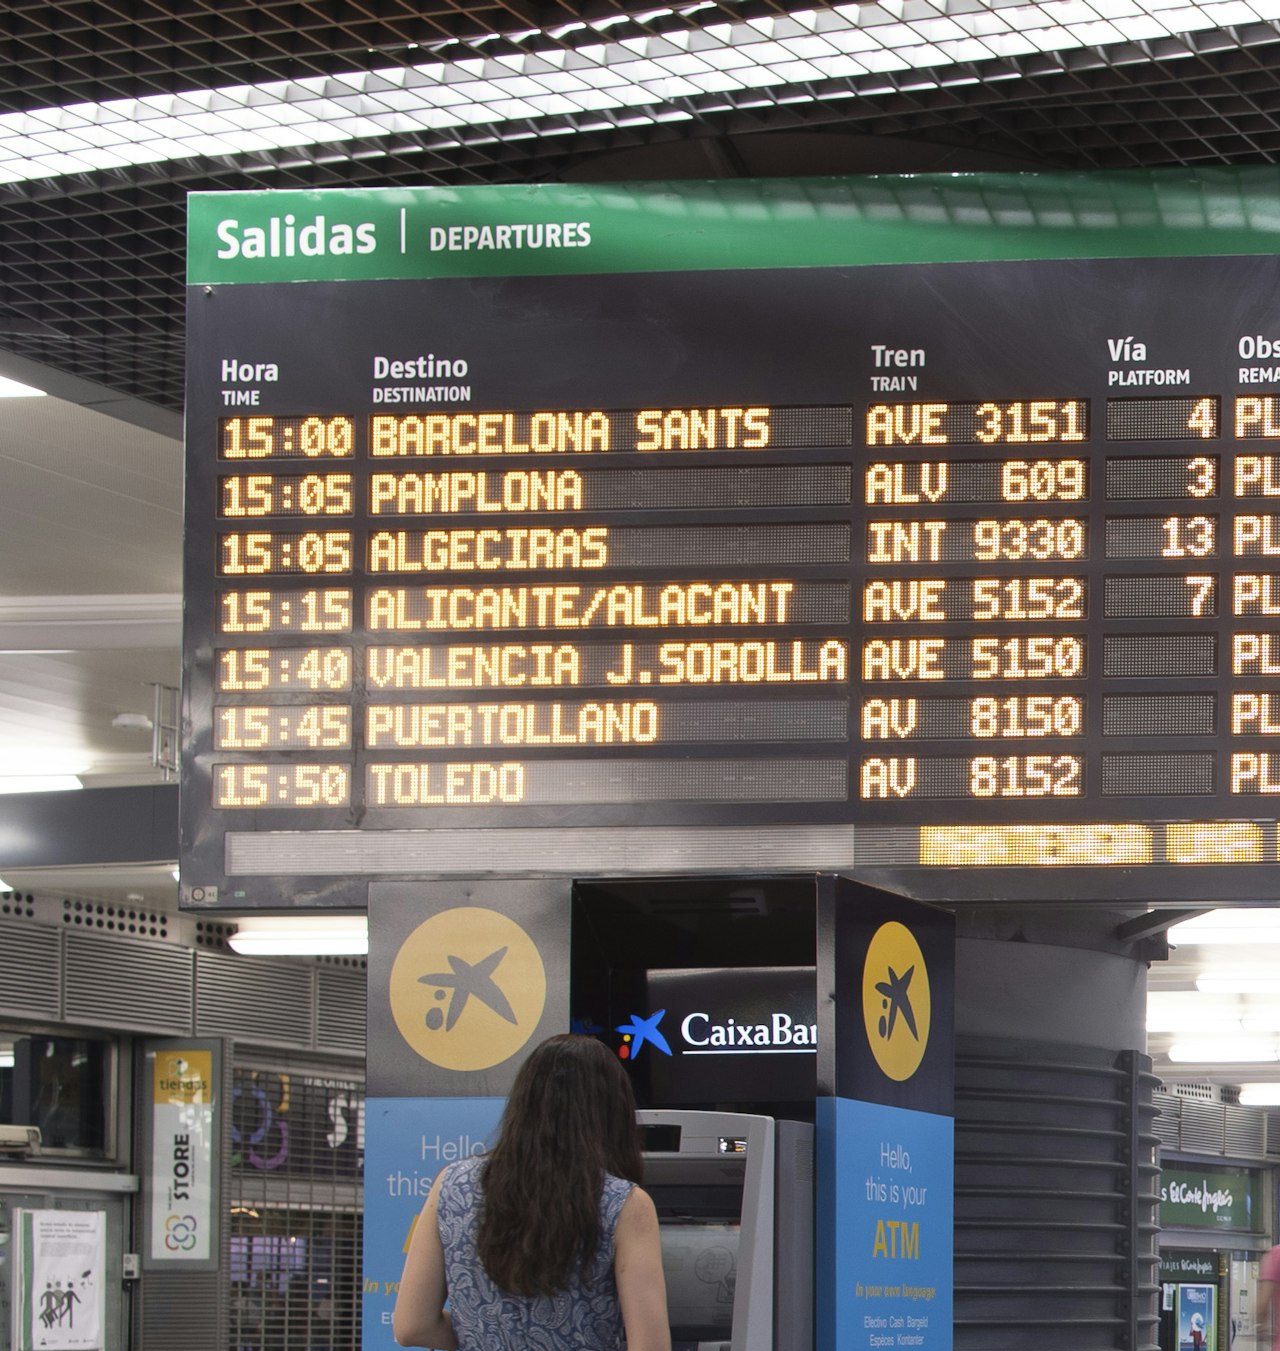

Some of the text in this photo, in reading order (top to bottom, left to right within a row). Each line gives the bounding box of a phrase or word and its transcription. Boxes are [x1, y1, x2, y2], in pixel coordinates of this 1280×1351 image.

[217, 214, 591, 259] Salidas DEPARTURES
[222, 360, 278, 381] Hora
[375, 354, 467, 378] Destino
[871, 345, 925, 367] Tren
[1108, 337, 1146, 361] Vía
[222, 391, 259, 405] TIME
[373, 386, 470, 402] DESTINATION
[871, 377, 917, 391] TRAIN
[1109, 370, 1189, 385] PLATFORM
[225, 417, 352, 458] 15:00
[372, 411, 610, 456] BARCELONA
[637, 408, 770, 451] SANTS
[867, 404, 948, 445] AVE
[976, 401, 1083, 443] 3151
[1188, 398, 1214, 438] 4
[224, 474, 351, 516] 15:05
[371, 470, 582, 514] PAMPLONA
[865, 462, 947, 504] ALV
[1002, 460, 1083, 501] 609
[1187, 457, 1214, 497] 3
[223, 532, 350, 574] 15:05
[371, 528, 608, 572] ALGECIRAS
[869, 521, 946, 562] INT
[974, 519, 1083, 560] 9330
[1162, 516, 1213, 557] 13
[223, 590, 349, 632] 15:15
[370, 583, 793, 630] ALICANTE/ALACANT
[865, 580, 946, 621] AVE
[973, 578, 1082, 620] 5152
[1186, 576, 1212, 616] 7
[221, 649, 348, 690] 15:40
[369, 645, 579, 688] VALENCIA
[606, 640, 846, 684] J.SOROLLA
[864, 639, 945, 680] AVE
[973, 637, 1081, 678] 5150
[220, 706, 348, 748] 15:45
[368, 702, 658, 746] PUERTOLLANO
[863, 698, 916, 739] AV
[972, 696, 1080, 737] 8150
[220, 765, 347, 806] 15:50
[371, 762, 524, 804] TOLEDO
[862, 758, 915, 798] AV
[971, 755, 1079, 797] 8152
[174, 1134, 189, 1200] STORE
[880, 1142, 912, 1173] Hello,
[866, 1176, 927, 1210] this is your
[1180, 1183, 1201, 1205] Corte
[1201, 1180, 1232, 1212] Inglés
[872, 1220, 919, 1260] ATM
